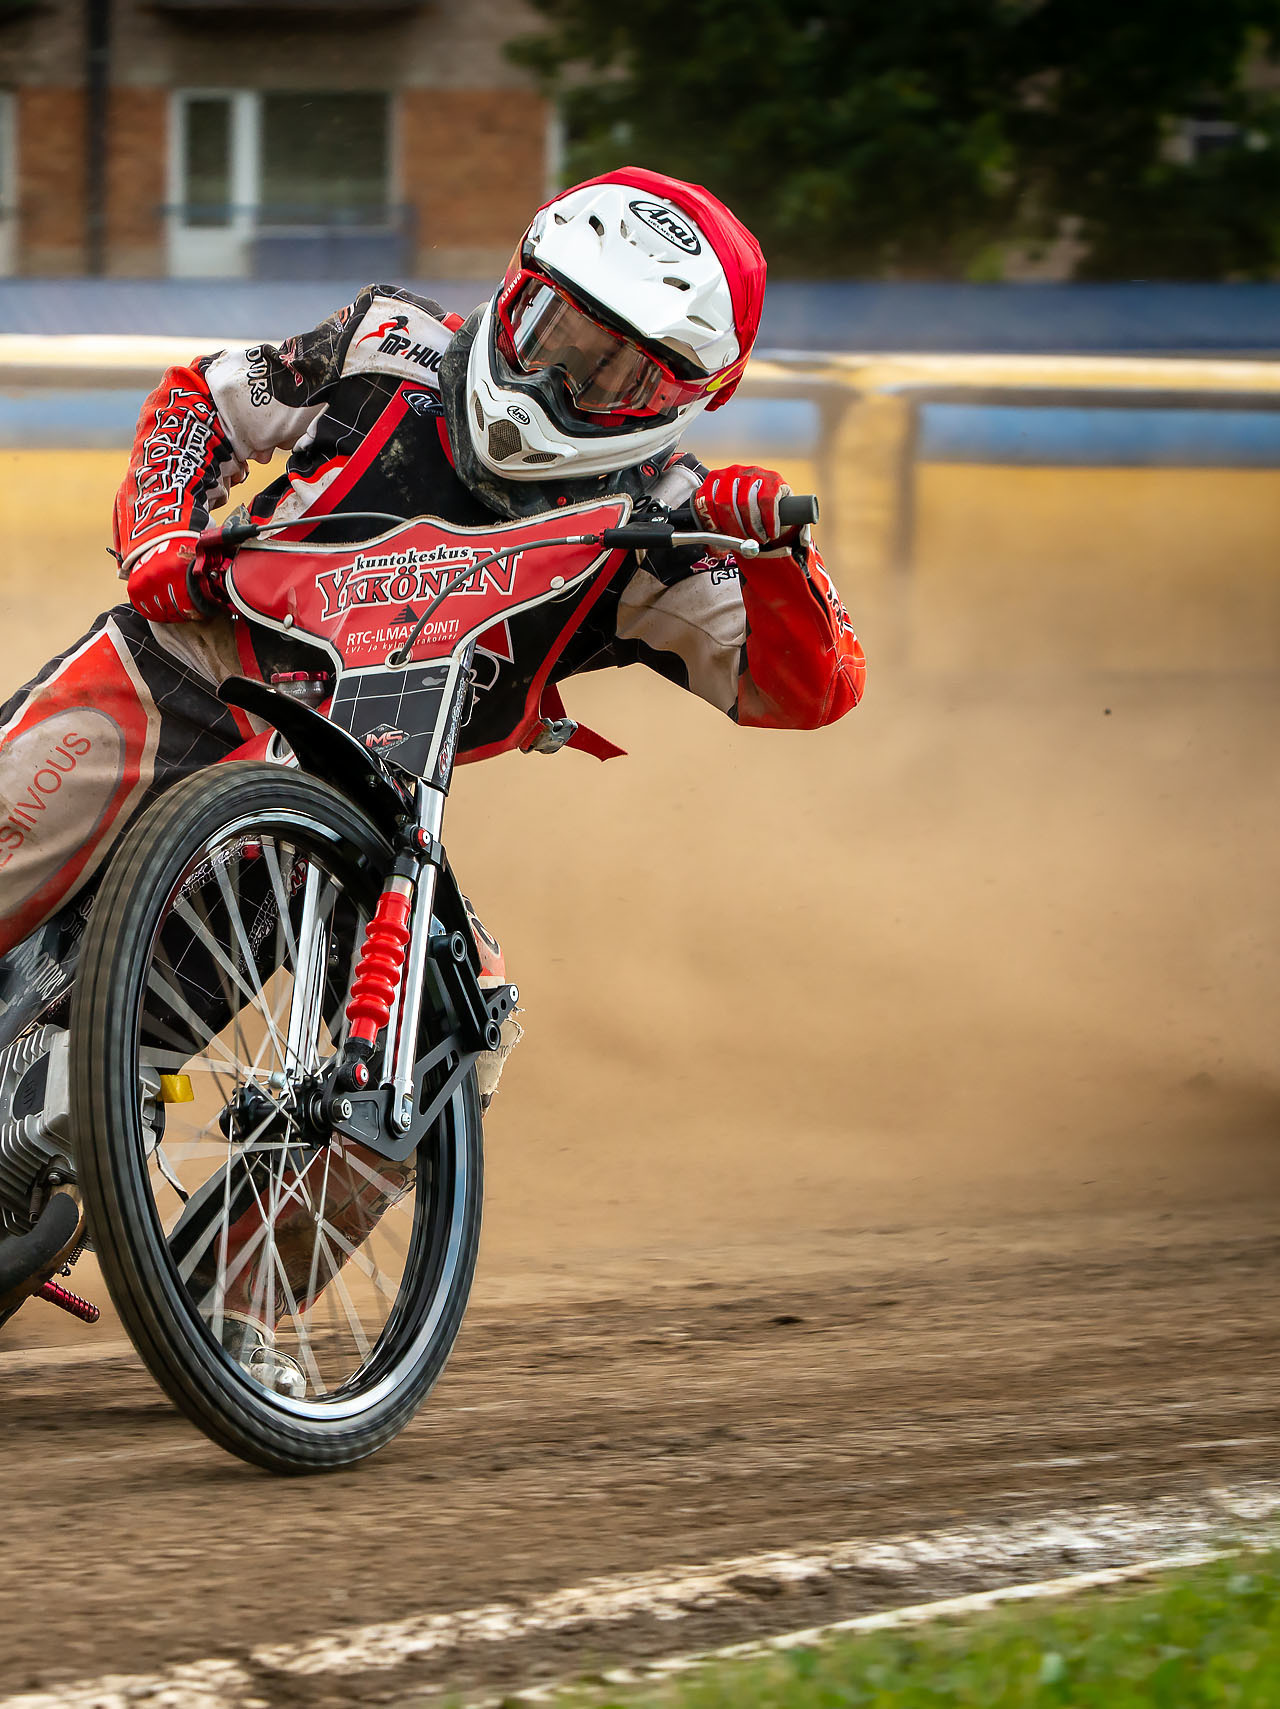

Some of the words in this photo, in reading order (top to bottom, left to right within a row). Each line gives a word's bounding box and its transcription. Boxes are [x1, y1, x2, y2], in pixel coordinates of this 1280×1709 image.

[633, 208, 697, 248] Arai
[501, 272, 522, 304] OAKLEY
[508, 408, 528, 422] Arai
[356, 546, 469, 571] kuntokeskus
[317, 549, 522, 620] YKKÖNEN
[367, 643, 379, 654] ja
